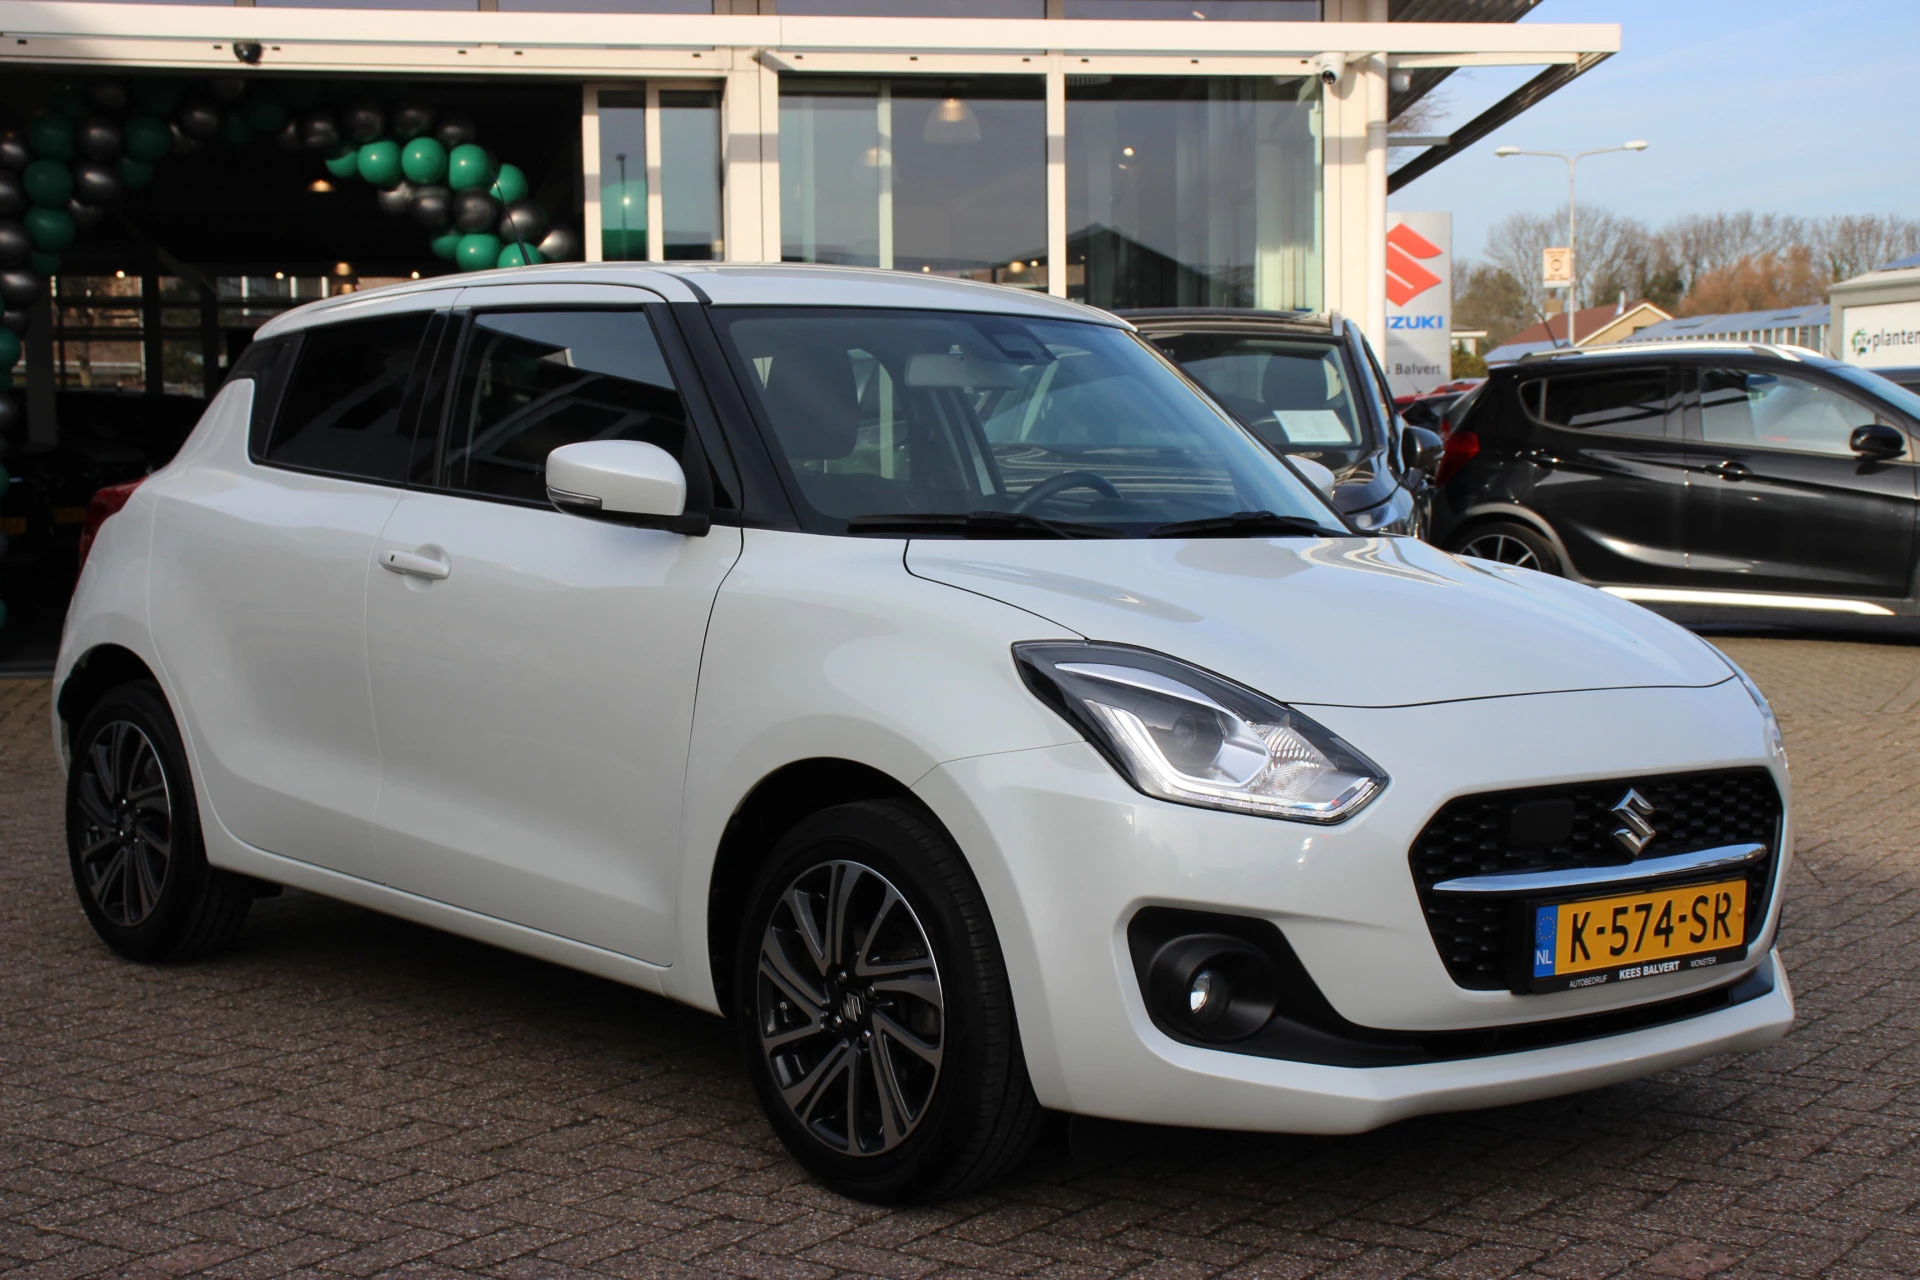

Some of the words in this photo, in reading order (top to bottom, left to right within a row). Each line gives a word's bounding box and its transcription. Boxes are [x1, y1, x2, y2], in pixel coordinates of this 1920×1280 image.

[1385, 315, 1444, 329] ZUKI
[1395, 363, 1441, 375] Balvert
[1570, 891, 1732, 963] K-574-SR
[1536, 950, 1552, 965] NL
[1619, 967, 1641, 979] KEES
[1643, 961, 1680, 976] BALVERT
[1690, 957, 1717, 968] MONSTER
